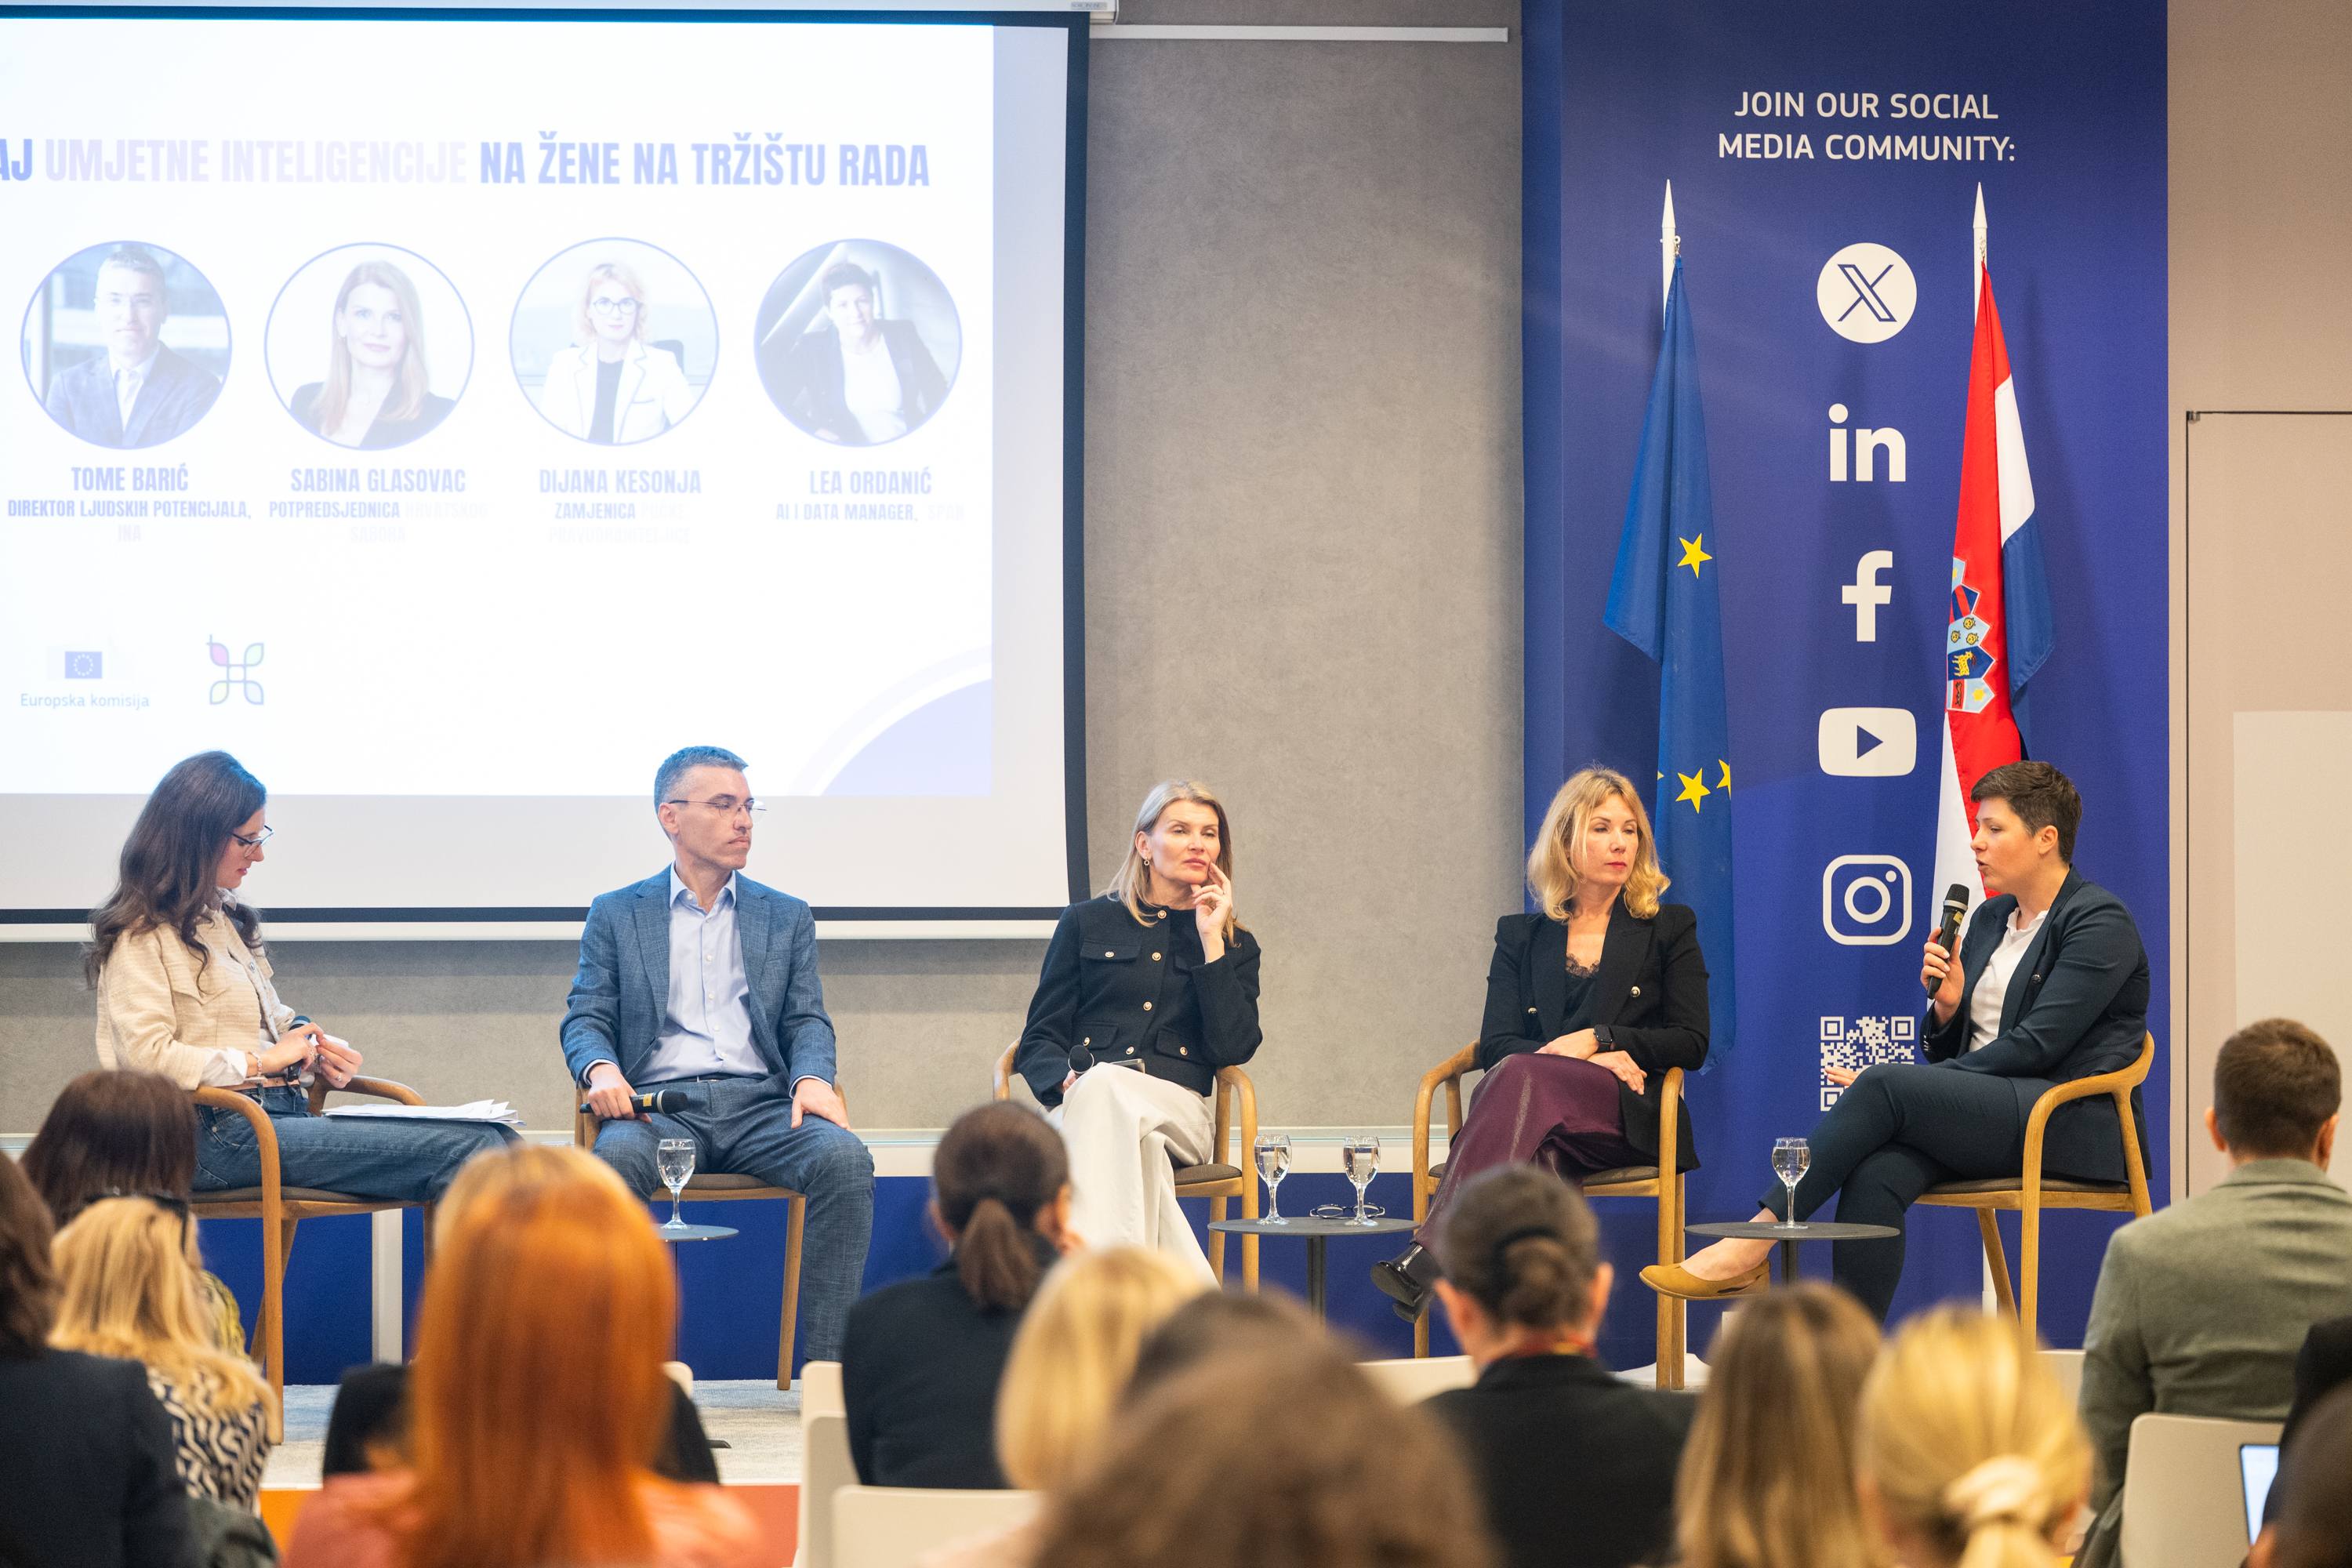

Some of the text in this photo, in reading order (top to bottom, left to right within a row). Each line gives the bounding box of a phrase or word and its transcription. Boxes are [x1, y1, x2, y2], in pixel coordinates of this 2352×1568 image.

[1734, 91, 1998, 118] JOIN OUR SOCIAL
[45, 139, 209, 182] UMJETNE
[222, 140, 466, 183] INTELIGENCIJE
[480, 142, 525, 183] NA
[538, 130, 620, 184] ŽENE
[633, 143, 679, 185] NA
[691, 132, 826, 186] TRŽIŠTU
[839, 144, 930, 187] RADA
[1719, 132, 2015, 162] MEDIA COMMUNITY:
[71, 462, 189, 492] TOME BARIĆ
[290, 467, 466, 493] SABINA GLASOVAC
[539, 469, 702, 494] DIJANA KESONJA
[809, 466, 932, 495] LEA ORDANIĆ
[8, 499, 252, 520] DIREKTOR LJUDSKIH POTENCIJALA,
[269, 501, 401, 518] POTPREDSJEDNICA
[555, 502, 636, 520] ZAMJENICA
[776, 503, 789, 521] AI
[803, 503, 840, 521] DATA
[844, 503, 919, 522] MANAGER,
[20, 693, 150, 710] Europska komisija
